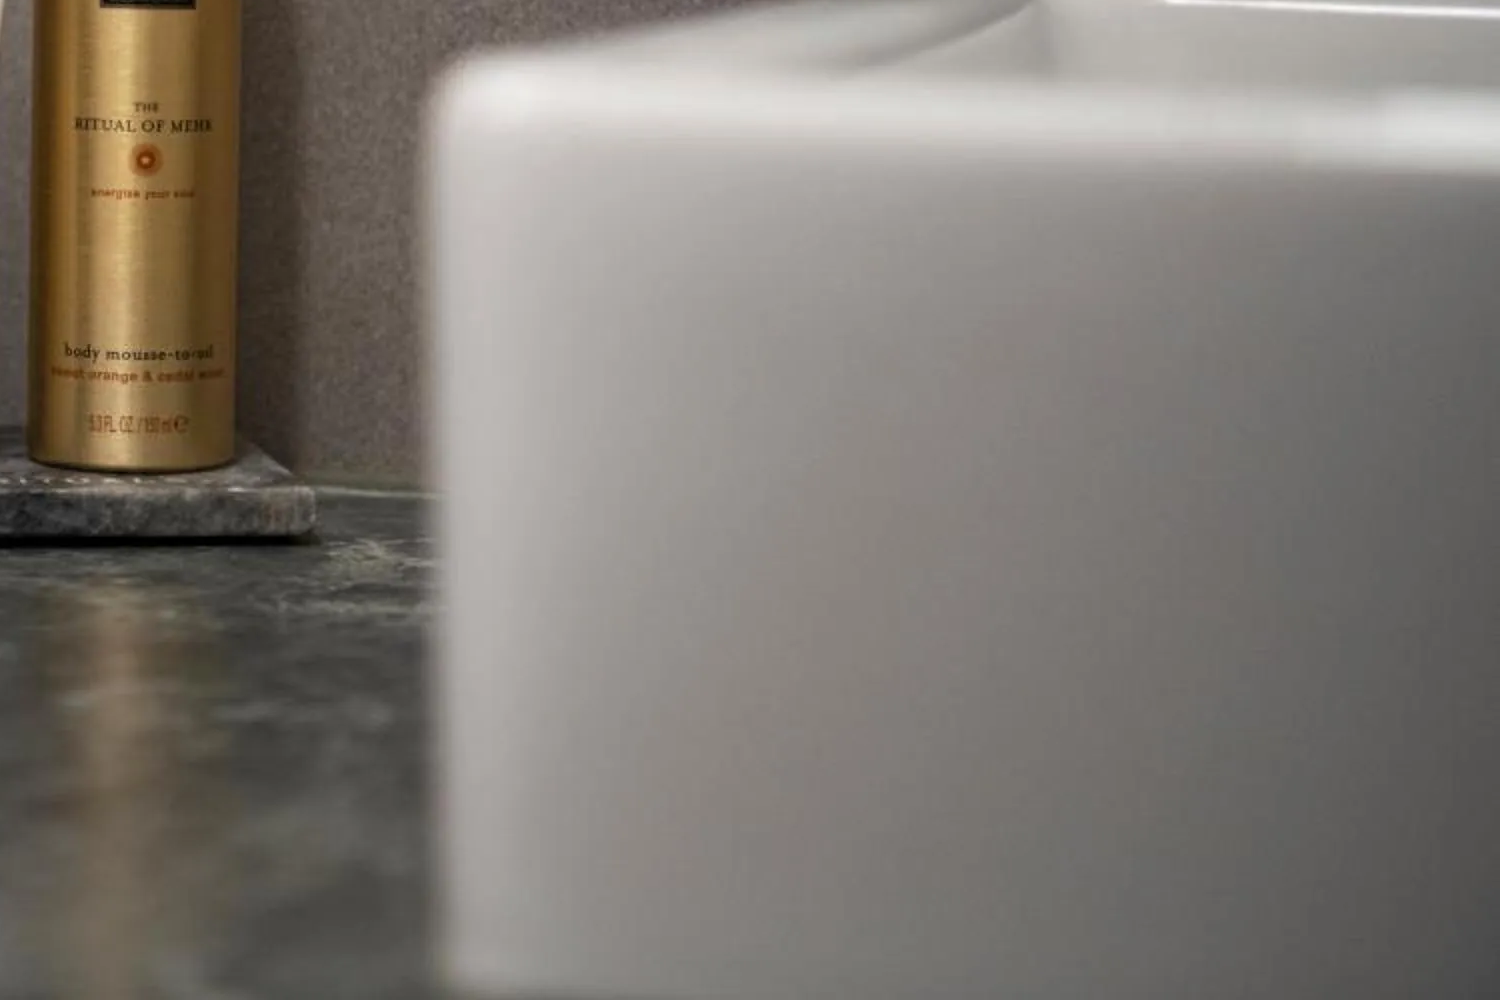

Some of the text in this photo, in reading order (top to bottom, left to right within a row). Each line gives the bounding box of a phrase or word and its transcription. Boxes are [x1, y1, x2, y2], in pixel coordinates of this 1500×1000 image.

[133, 102, 159, 113] THE
[75, 117, 137, 133] RITUAL
[141, 119, 165, 133] OF
[64, 342, 100, 363] body
